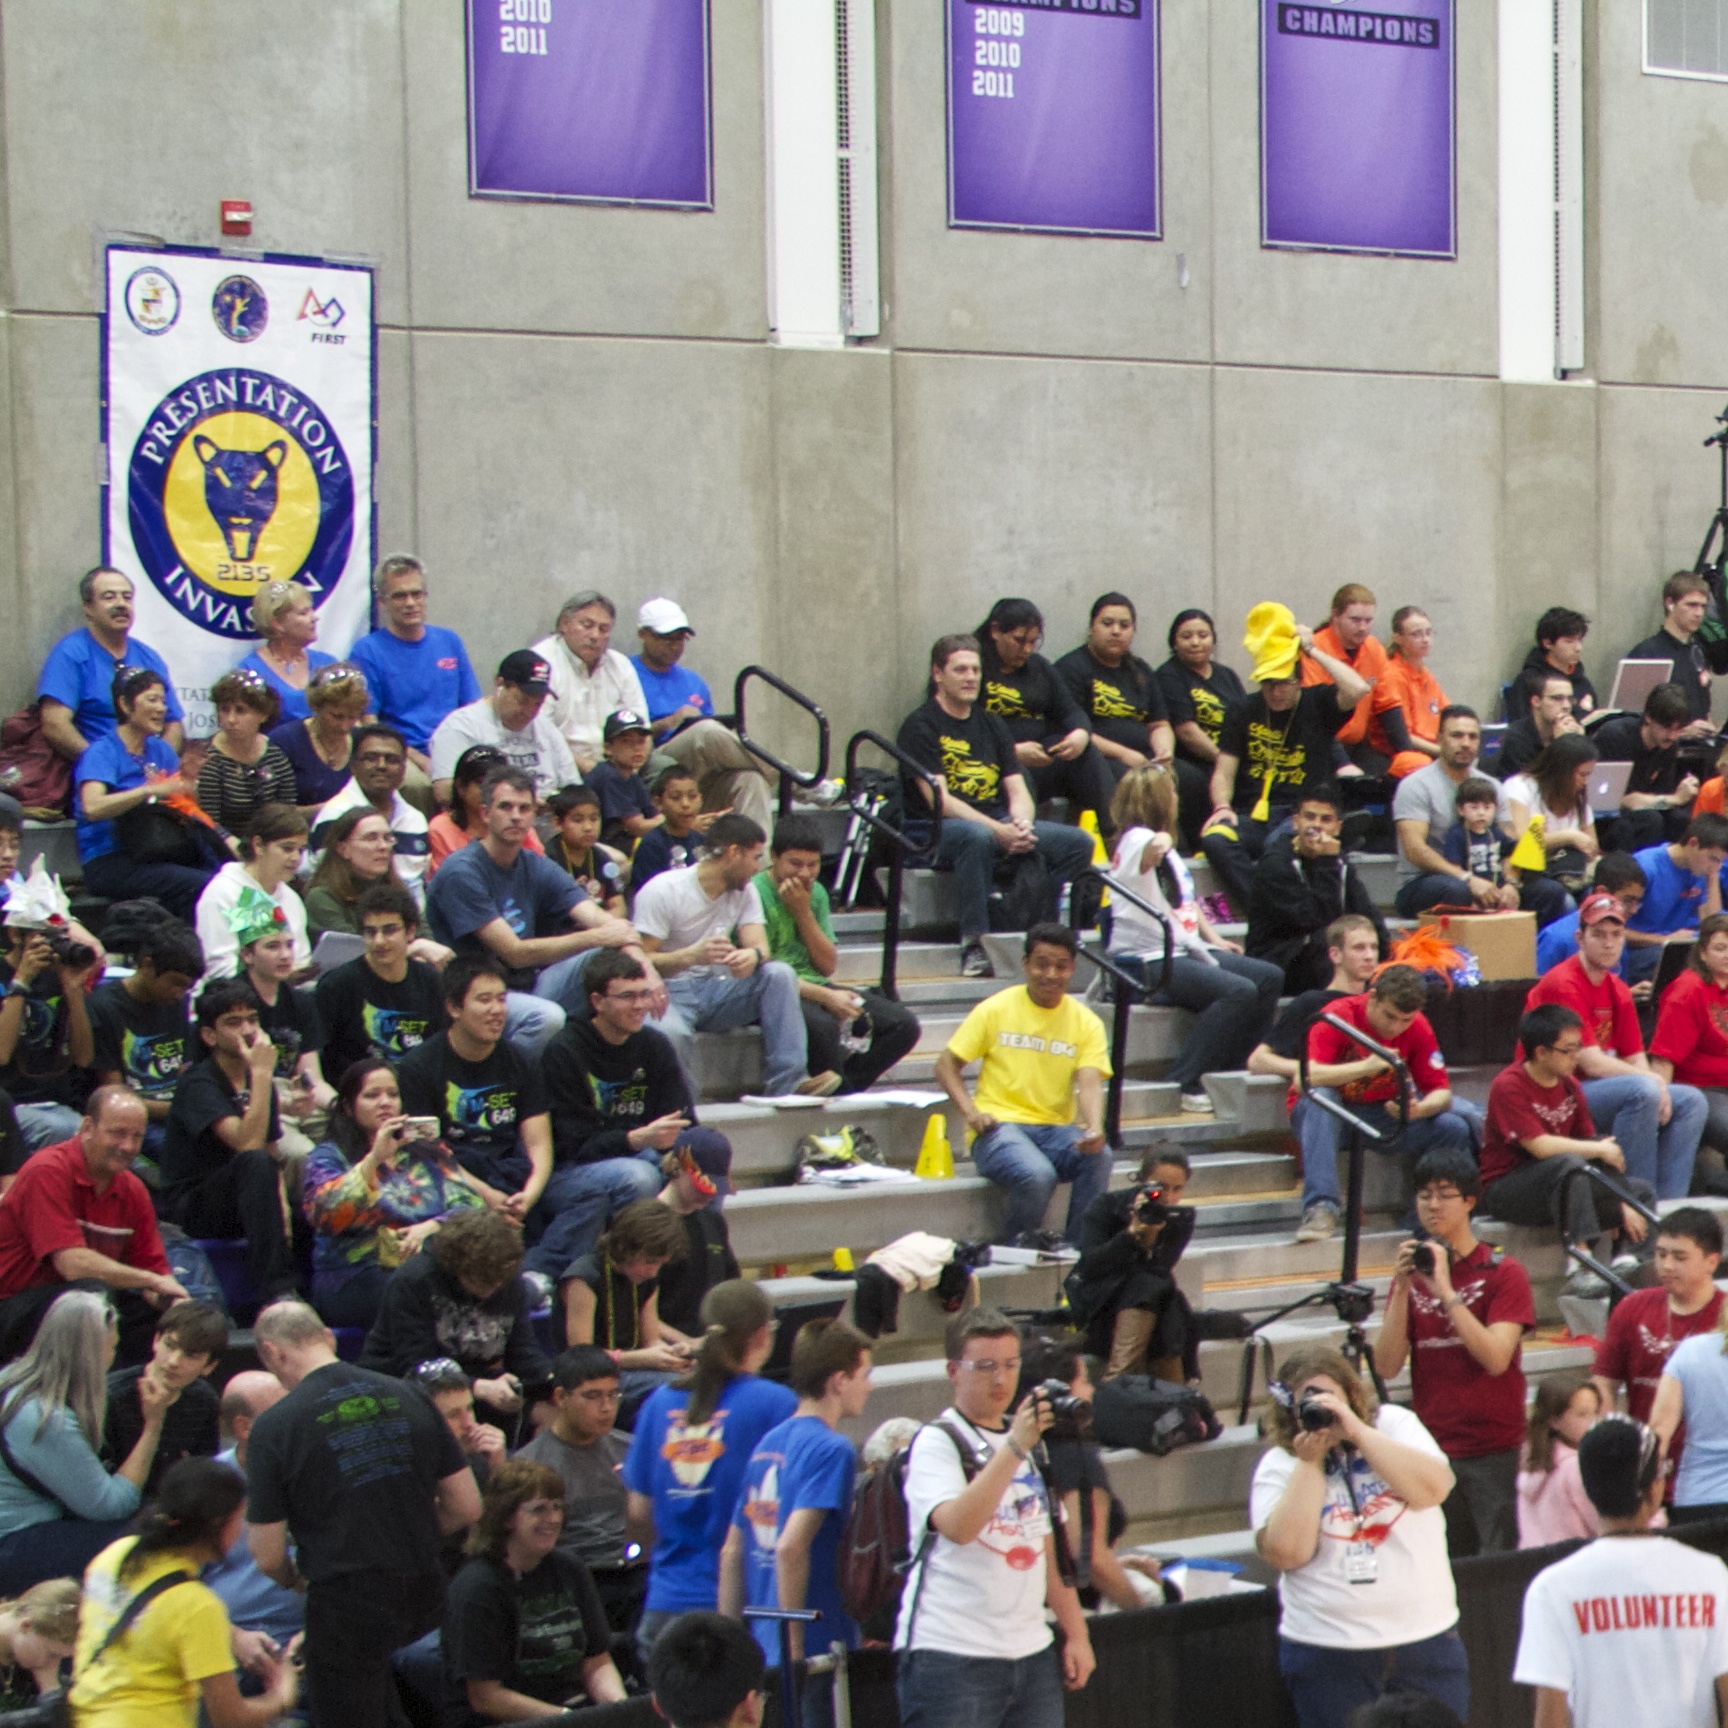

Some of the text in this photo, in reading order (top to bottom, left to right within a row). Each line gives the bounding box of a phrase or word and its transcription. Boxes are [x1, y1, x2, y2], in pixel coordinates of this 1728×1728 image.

[975, 8, 1024, 38] 2009
[1285, 10, 1436, 46] CHAMPIONS
[500, 26, 549, 56] 2011
[974, 39, 1022, 69] 2010
[972, 69, 1015, 99] 2011
[311, 332, 347, 345] FIRST
[141, 375, 343, 475] PRESENTATION
[217, 563, 271, 583] 2135
[998, 1031, 1046, 1054] TEAM
[1572, 1592, 1717, 1637] VOLUNTEER
